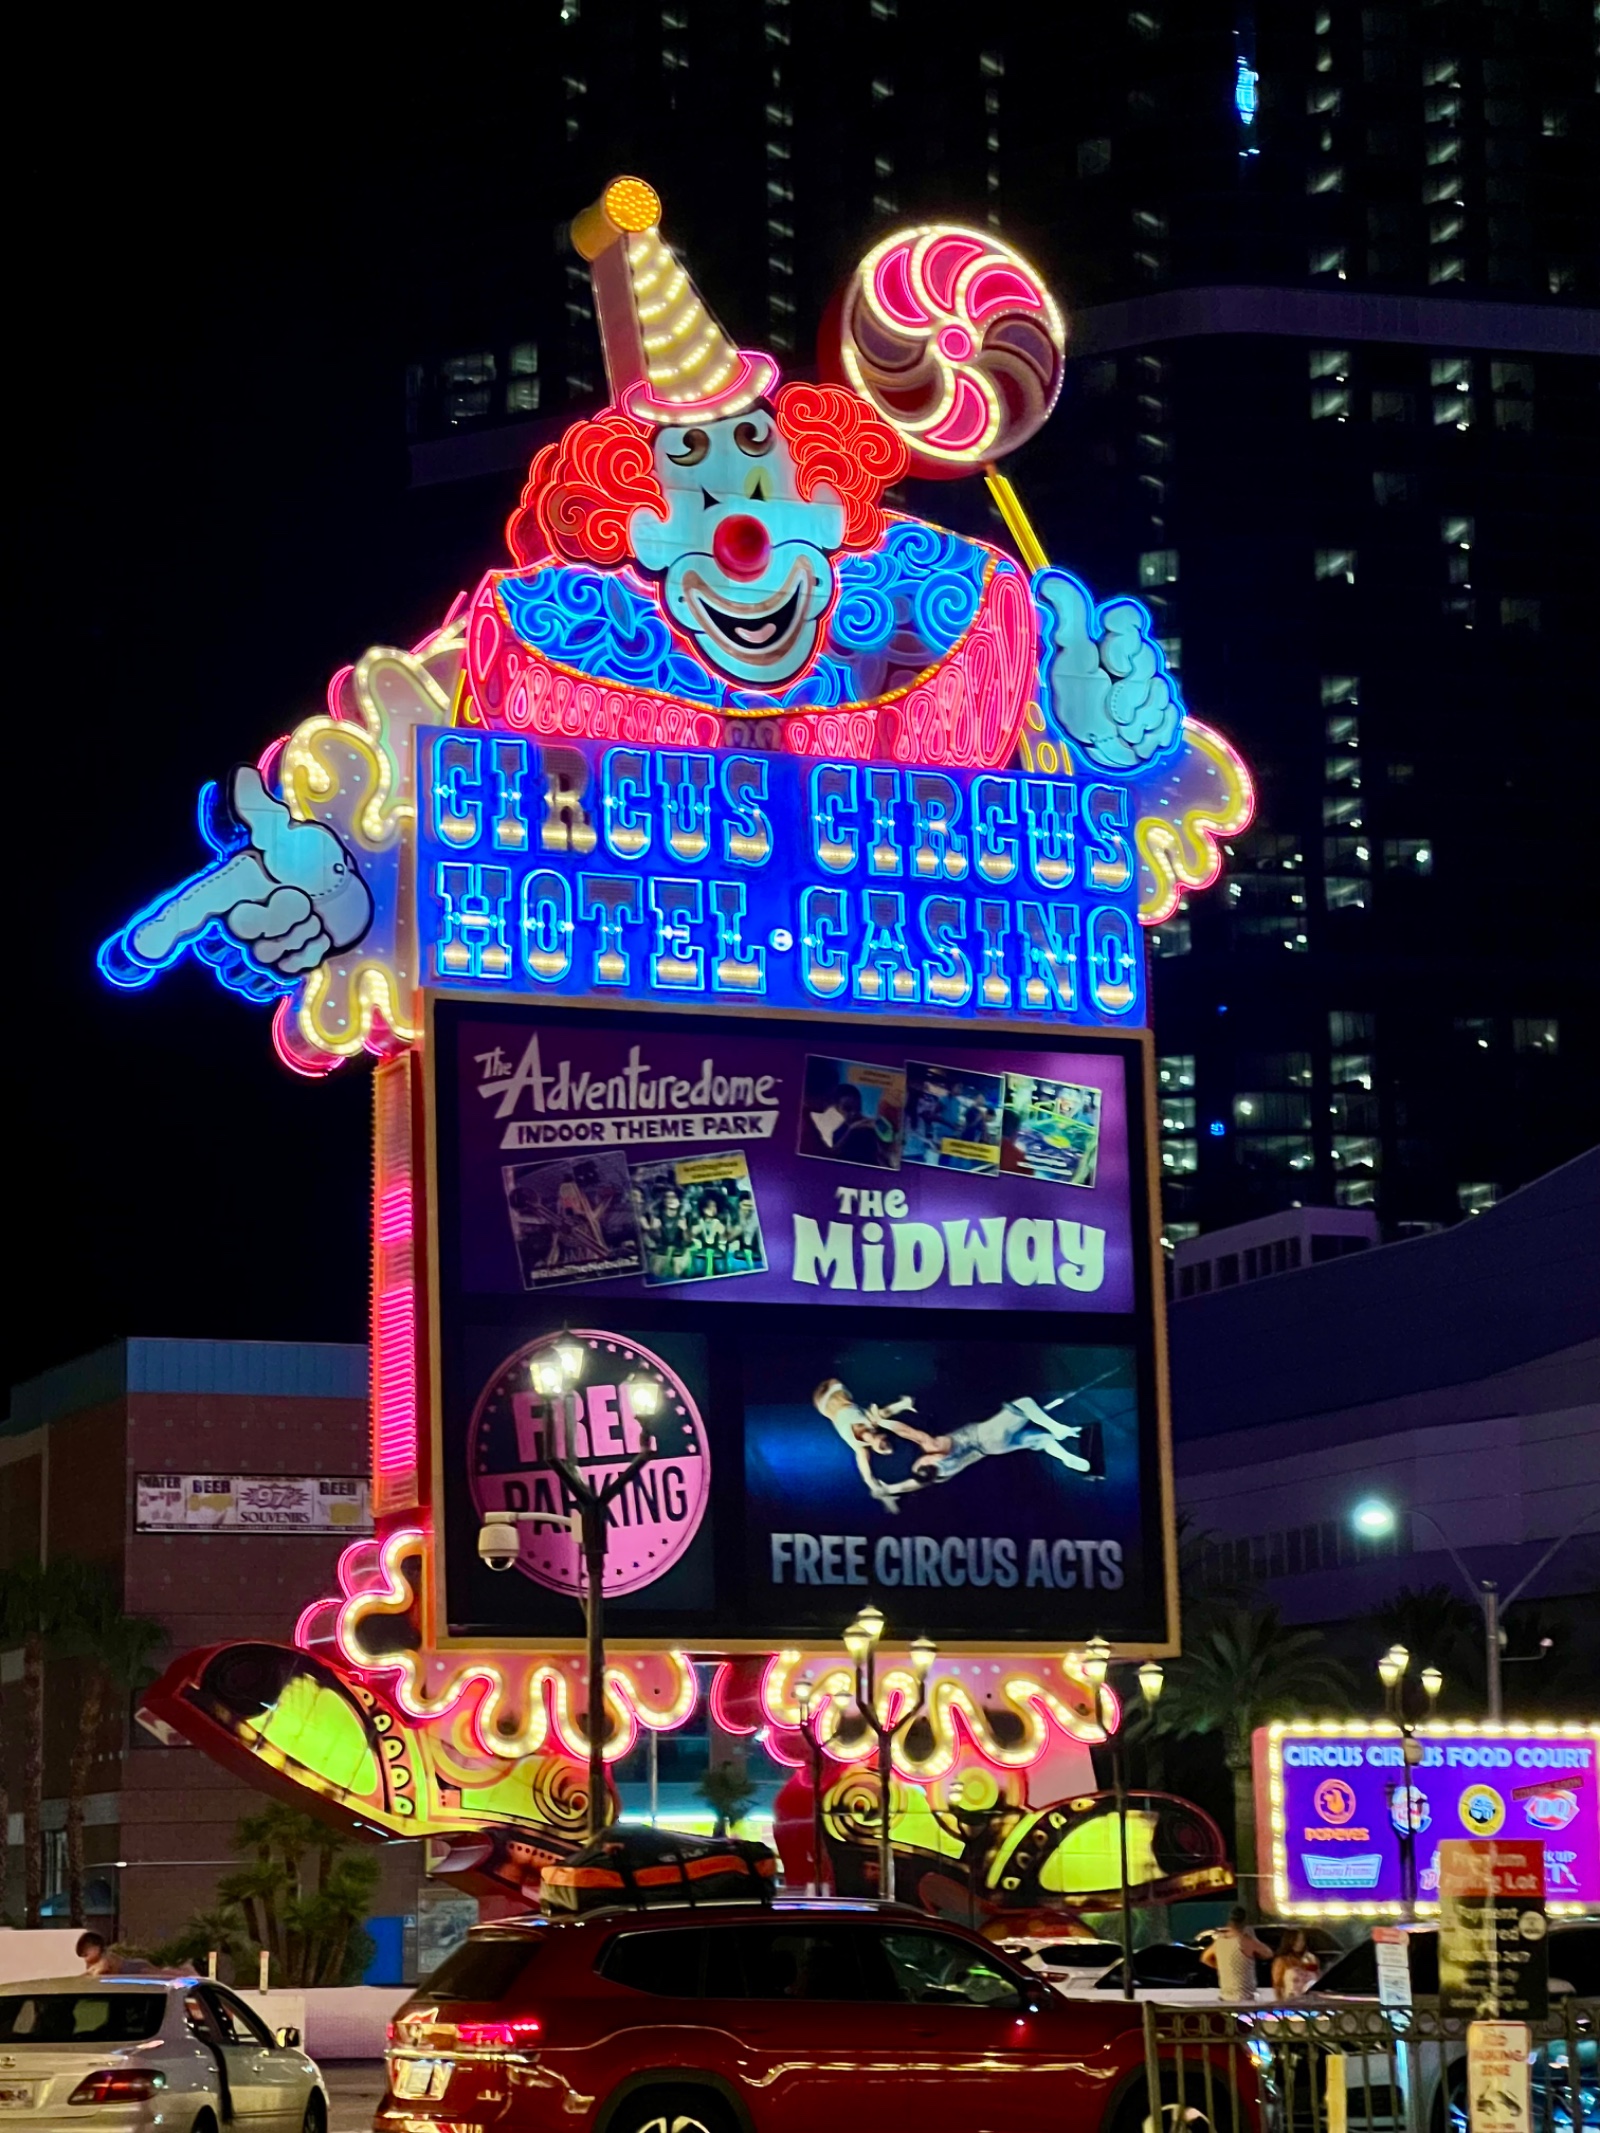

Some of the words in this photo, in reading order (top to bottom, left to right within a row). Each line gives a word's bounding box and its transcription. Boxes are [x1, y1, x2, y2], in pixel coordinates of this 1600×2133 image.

[431, 734, 775, 868] CIRCUS
[808, 763, 1136, 894] CIRCUS
[435, 863, 767, 995] HOTEL
[802, 886, 1138, 1016] CASINO
[473, 1046, 514, 1080] The
[477, 1031, 780, 1119] Adventuredome
[517, 1121, 606, 1145] INDOOR
[611, 1118, 695, 1140] THEME
[703, 1115, 764, 1136] PARK
[139, 1476, 182, 1489] WATER
[192, 1479, 232, 1494] BEER
[319, 1481, 357, 1496] BEER
[240, 1511, 311, 1524] SOUVENIRS
[770, 1532, 869, 1585] FREE
[874, 1536, 1020, 1588] CIRCUS
[1025, 1538, 1124, 1590] ACTS
[1284, 1745, 1363, 1768] CIRCUS
[1365, 1745, 1444, 1768] CIRUS
[1446, 1746, 1512, 1768] FOOD
[1514, 1747, 1592, 1769] COURT
[1304, 1827, 1370, 1842] POPEYES
